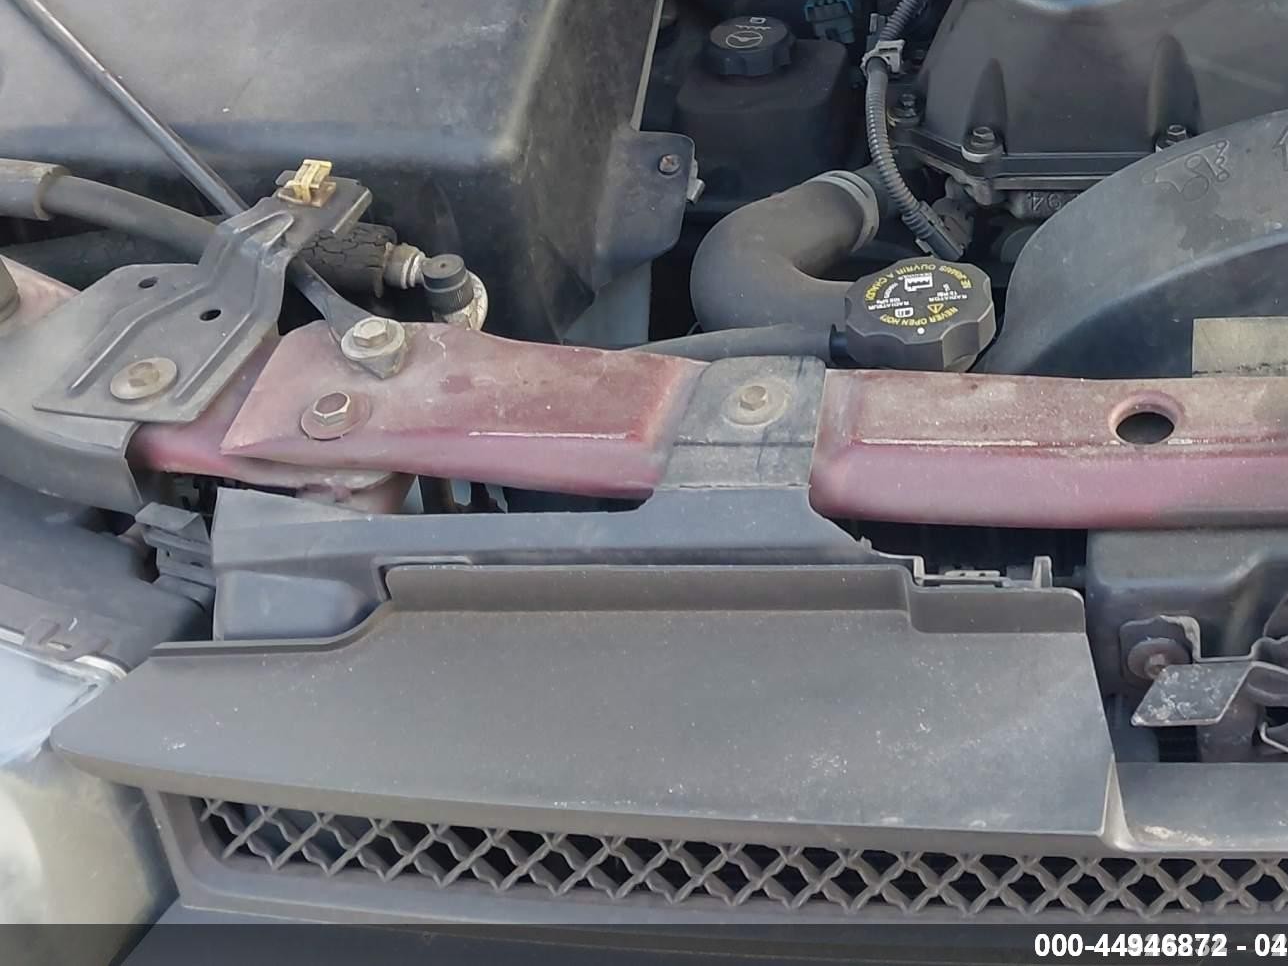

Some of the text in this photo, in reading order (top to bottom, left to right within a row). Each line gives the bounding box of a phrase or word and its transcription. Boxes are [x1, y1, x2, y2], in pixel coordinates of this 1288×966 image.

[896, 264, 937, 274] OUVRIR
[929, 306, 959, 323] NEVER
[901, 318, 928, 326] OPEN
